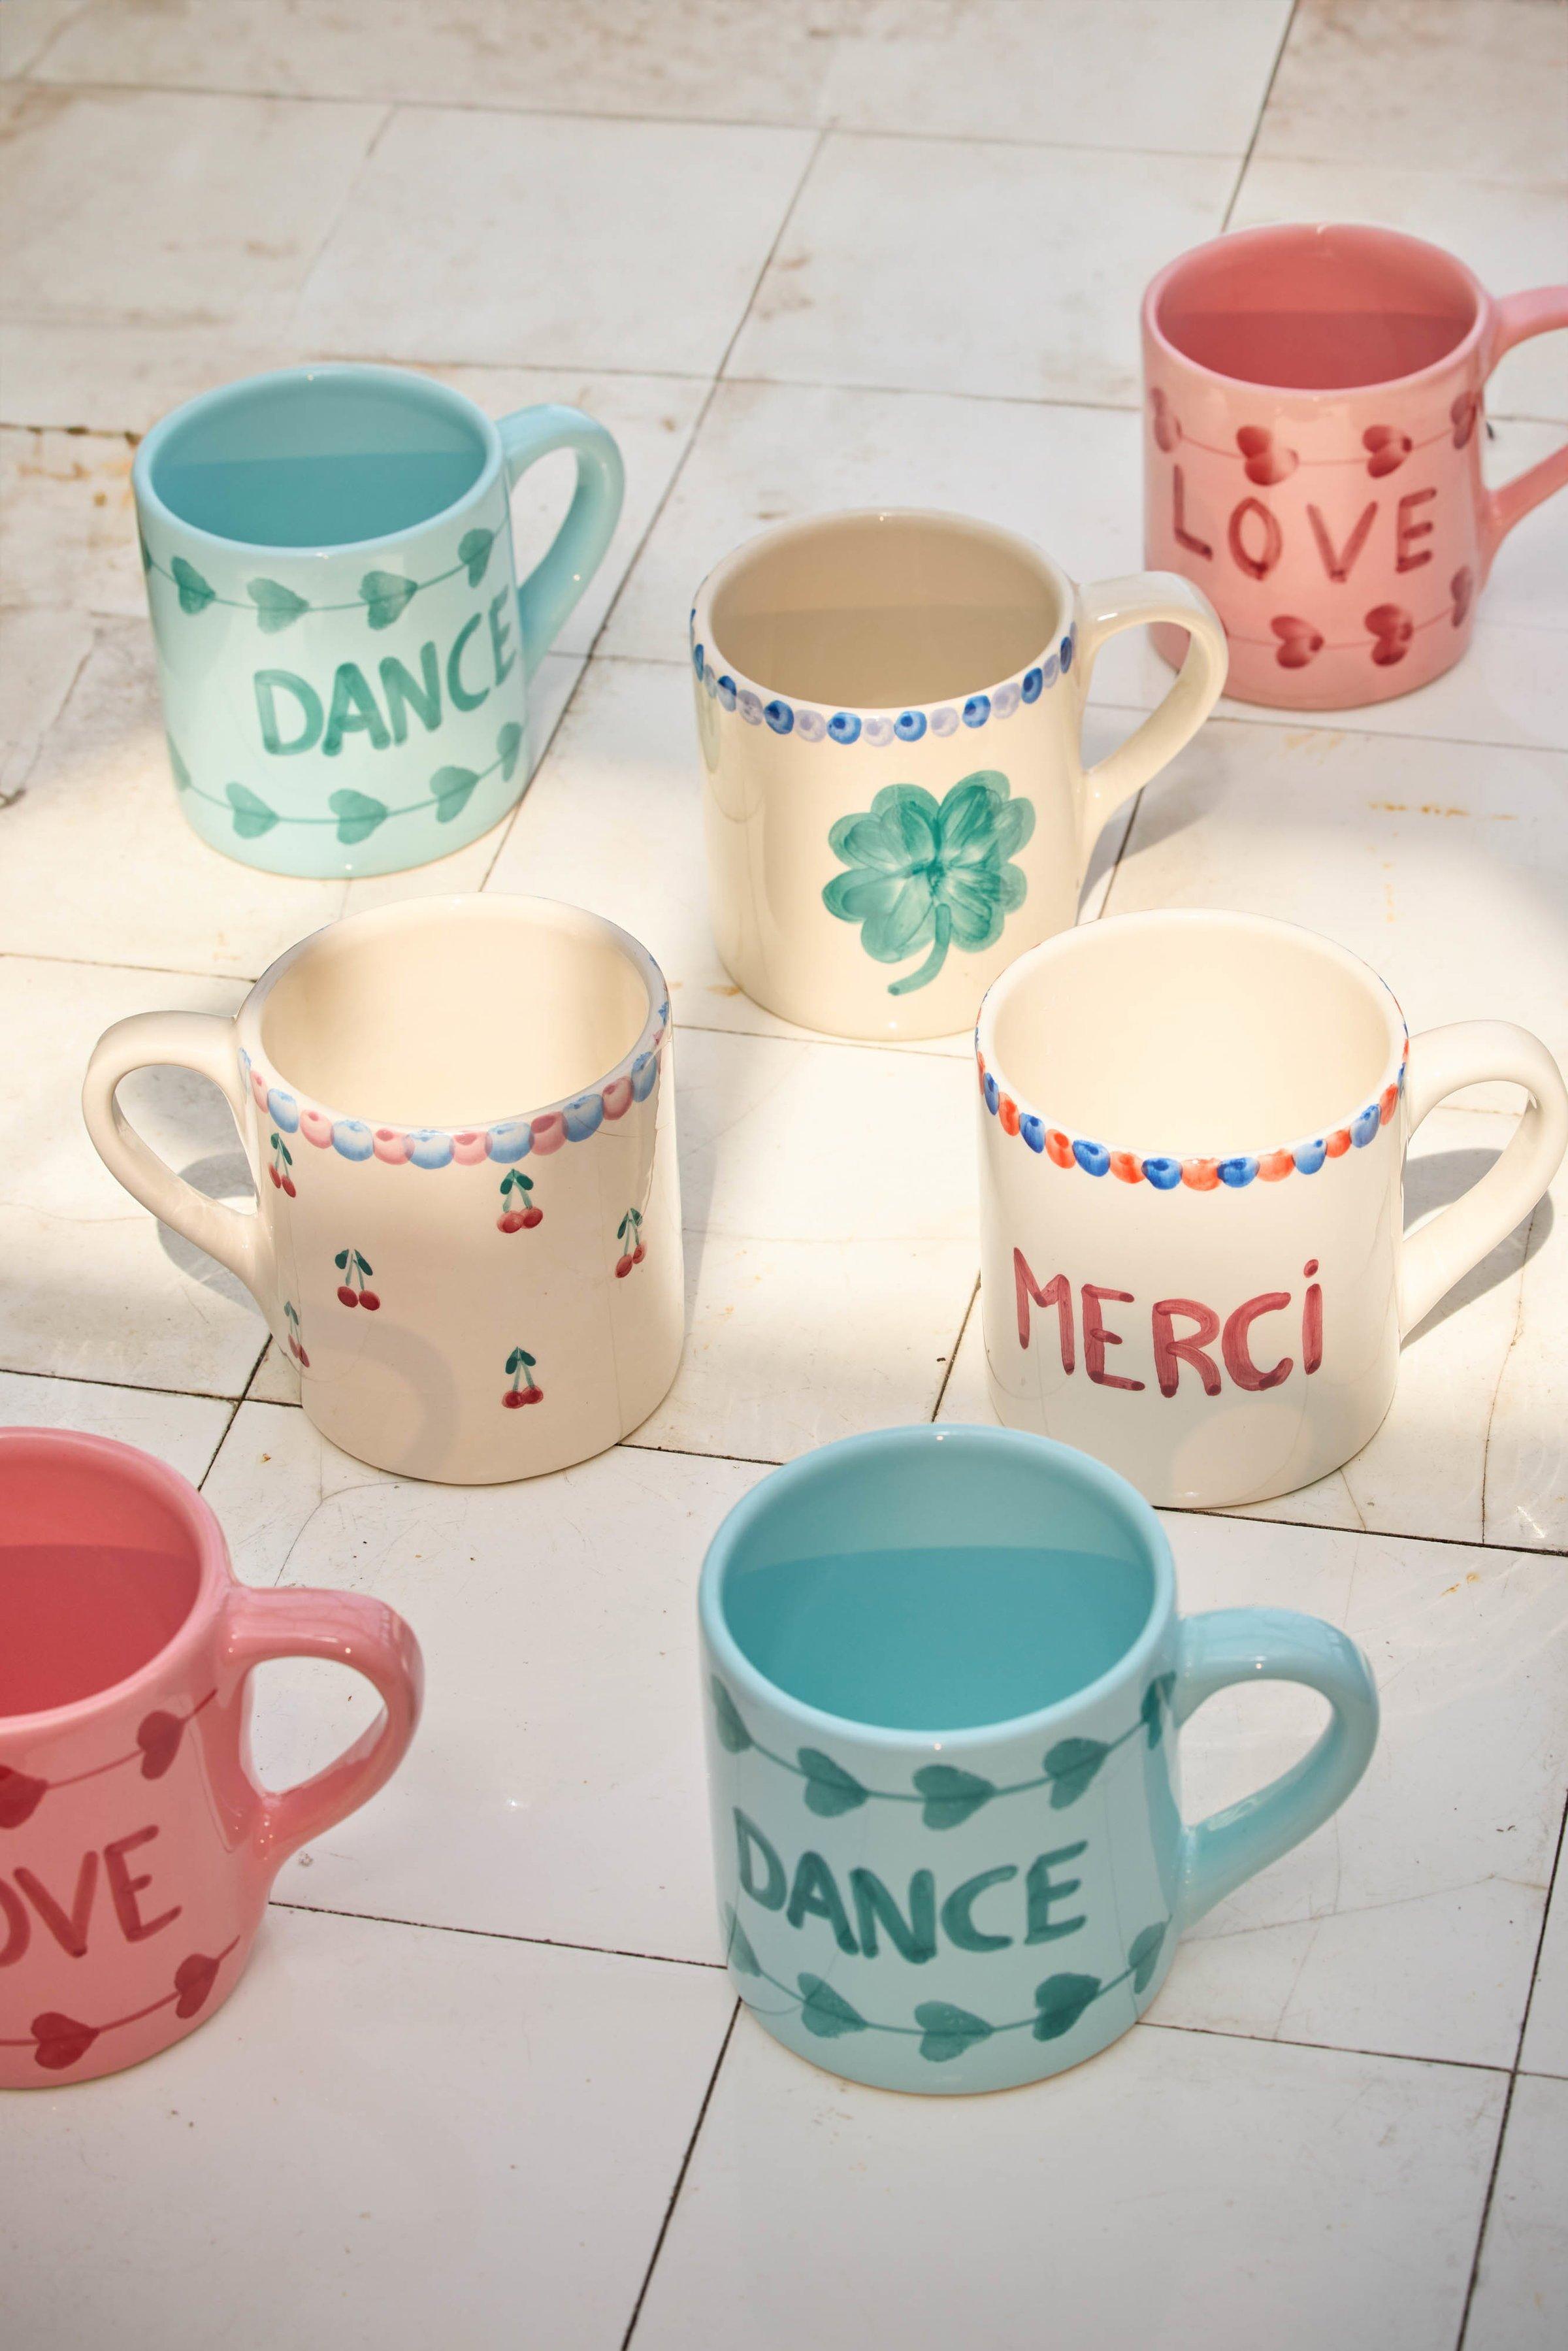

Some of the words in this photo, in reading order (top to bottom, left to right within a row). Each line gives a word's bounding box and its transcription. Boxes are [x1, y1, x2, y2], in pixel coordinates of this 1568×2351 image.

[1173, 464, 1437, 583] LOVE
[253, 584, 517, 757] DANCE
[732, 1806, 1088, 1965] DANCE
